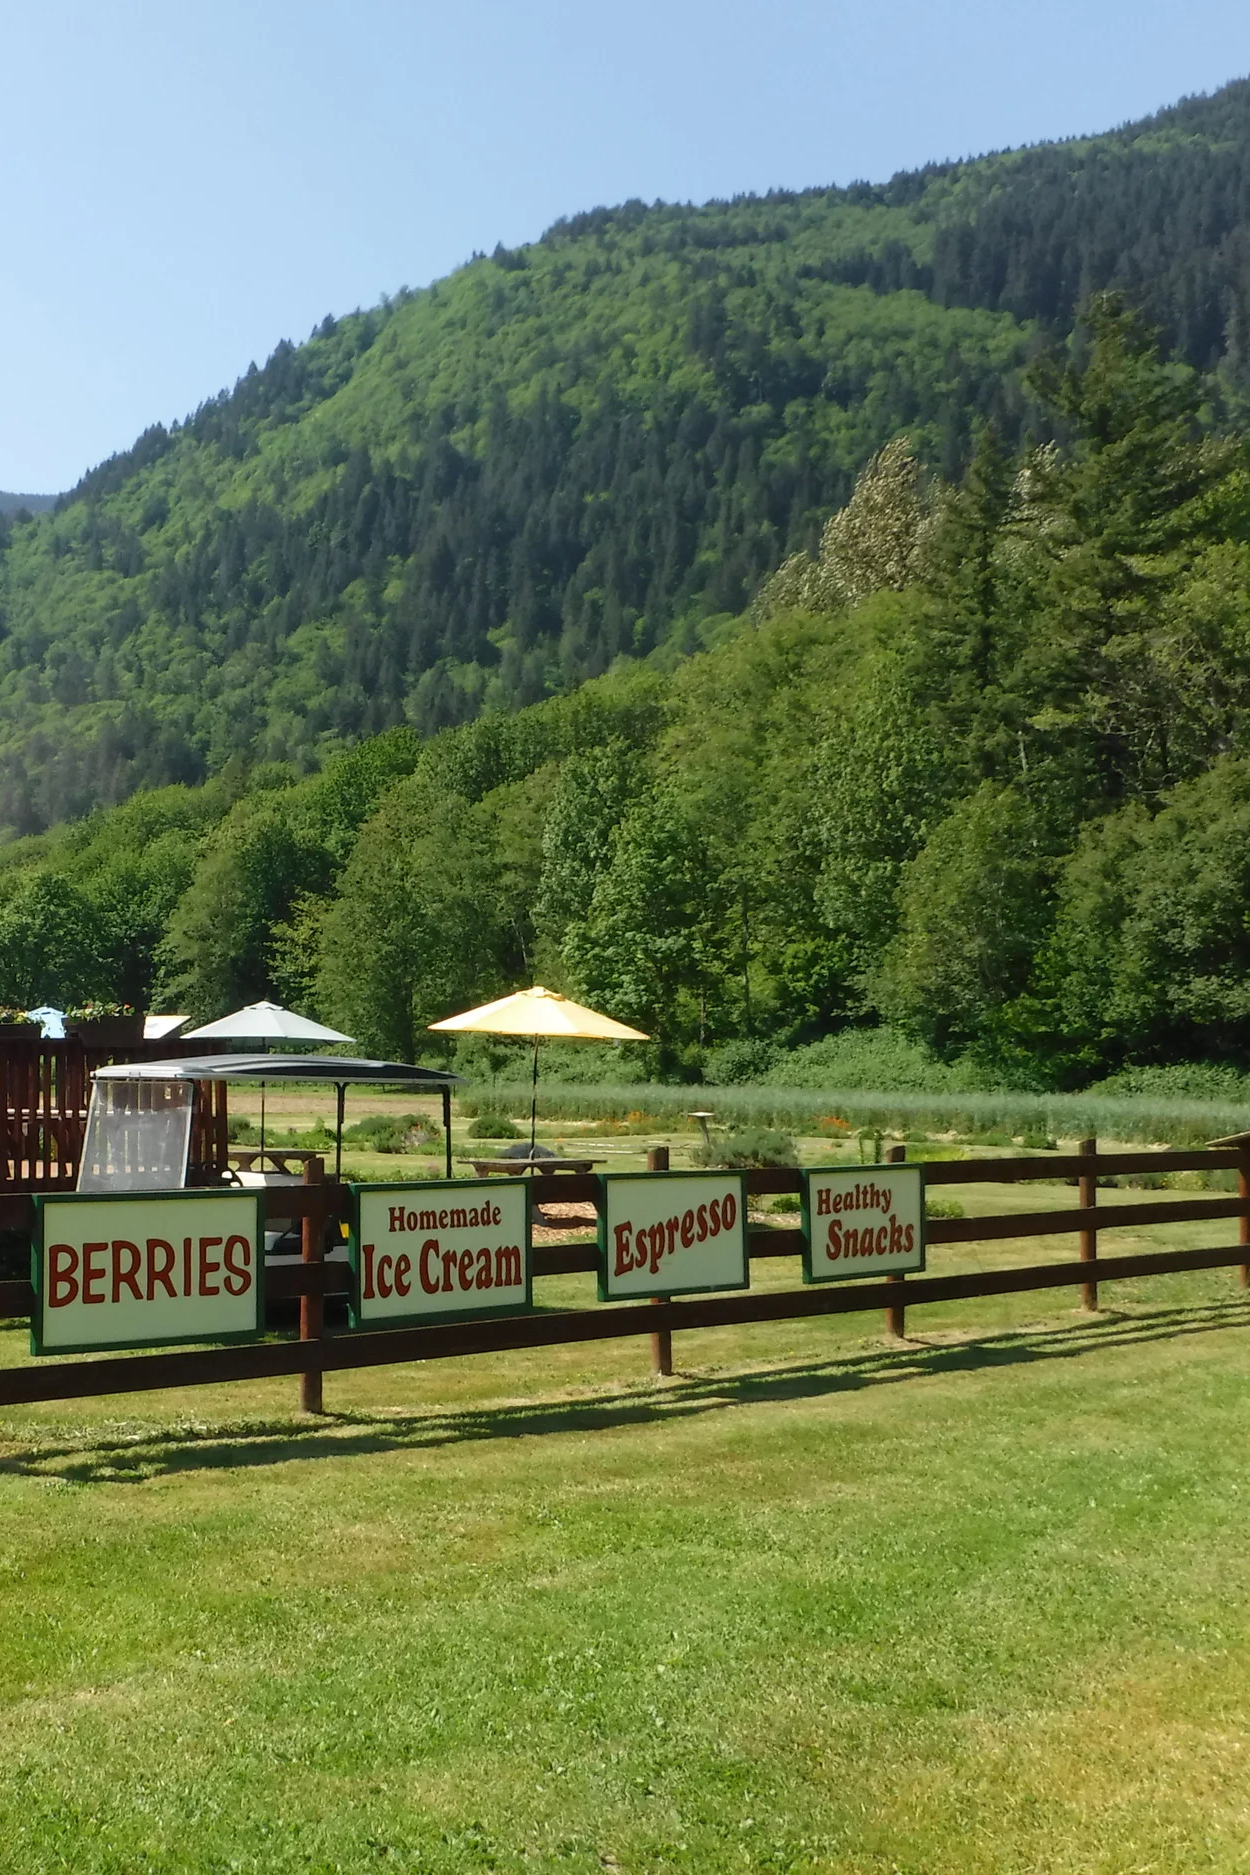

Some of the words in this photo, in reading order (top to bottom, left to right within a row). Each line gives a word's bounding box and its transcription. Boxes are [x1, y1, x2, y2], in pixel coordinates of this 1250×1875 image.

[388, 1200, 502, 1232] Homemade
[816, 1183, 893, 1216] Healthy
[613, 1193, 737, 1277] Espresso
[825, 1215, 915, 1261] Snacks
[48, 1234, 252, 1308] BERRIES
[362, 1243, 412, 1300] Ice
[419, 1238, 523, 1295] Cream
